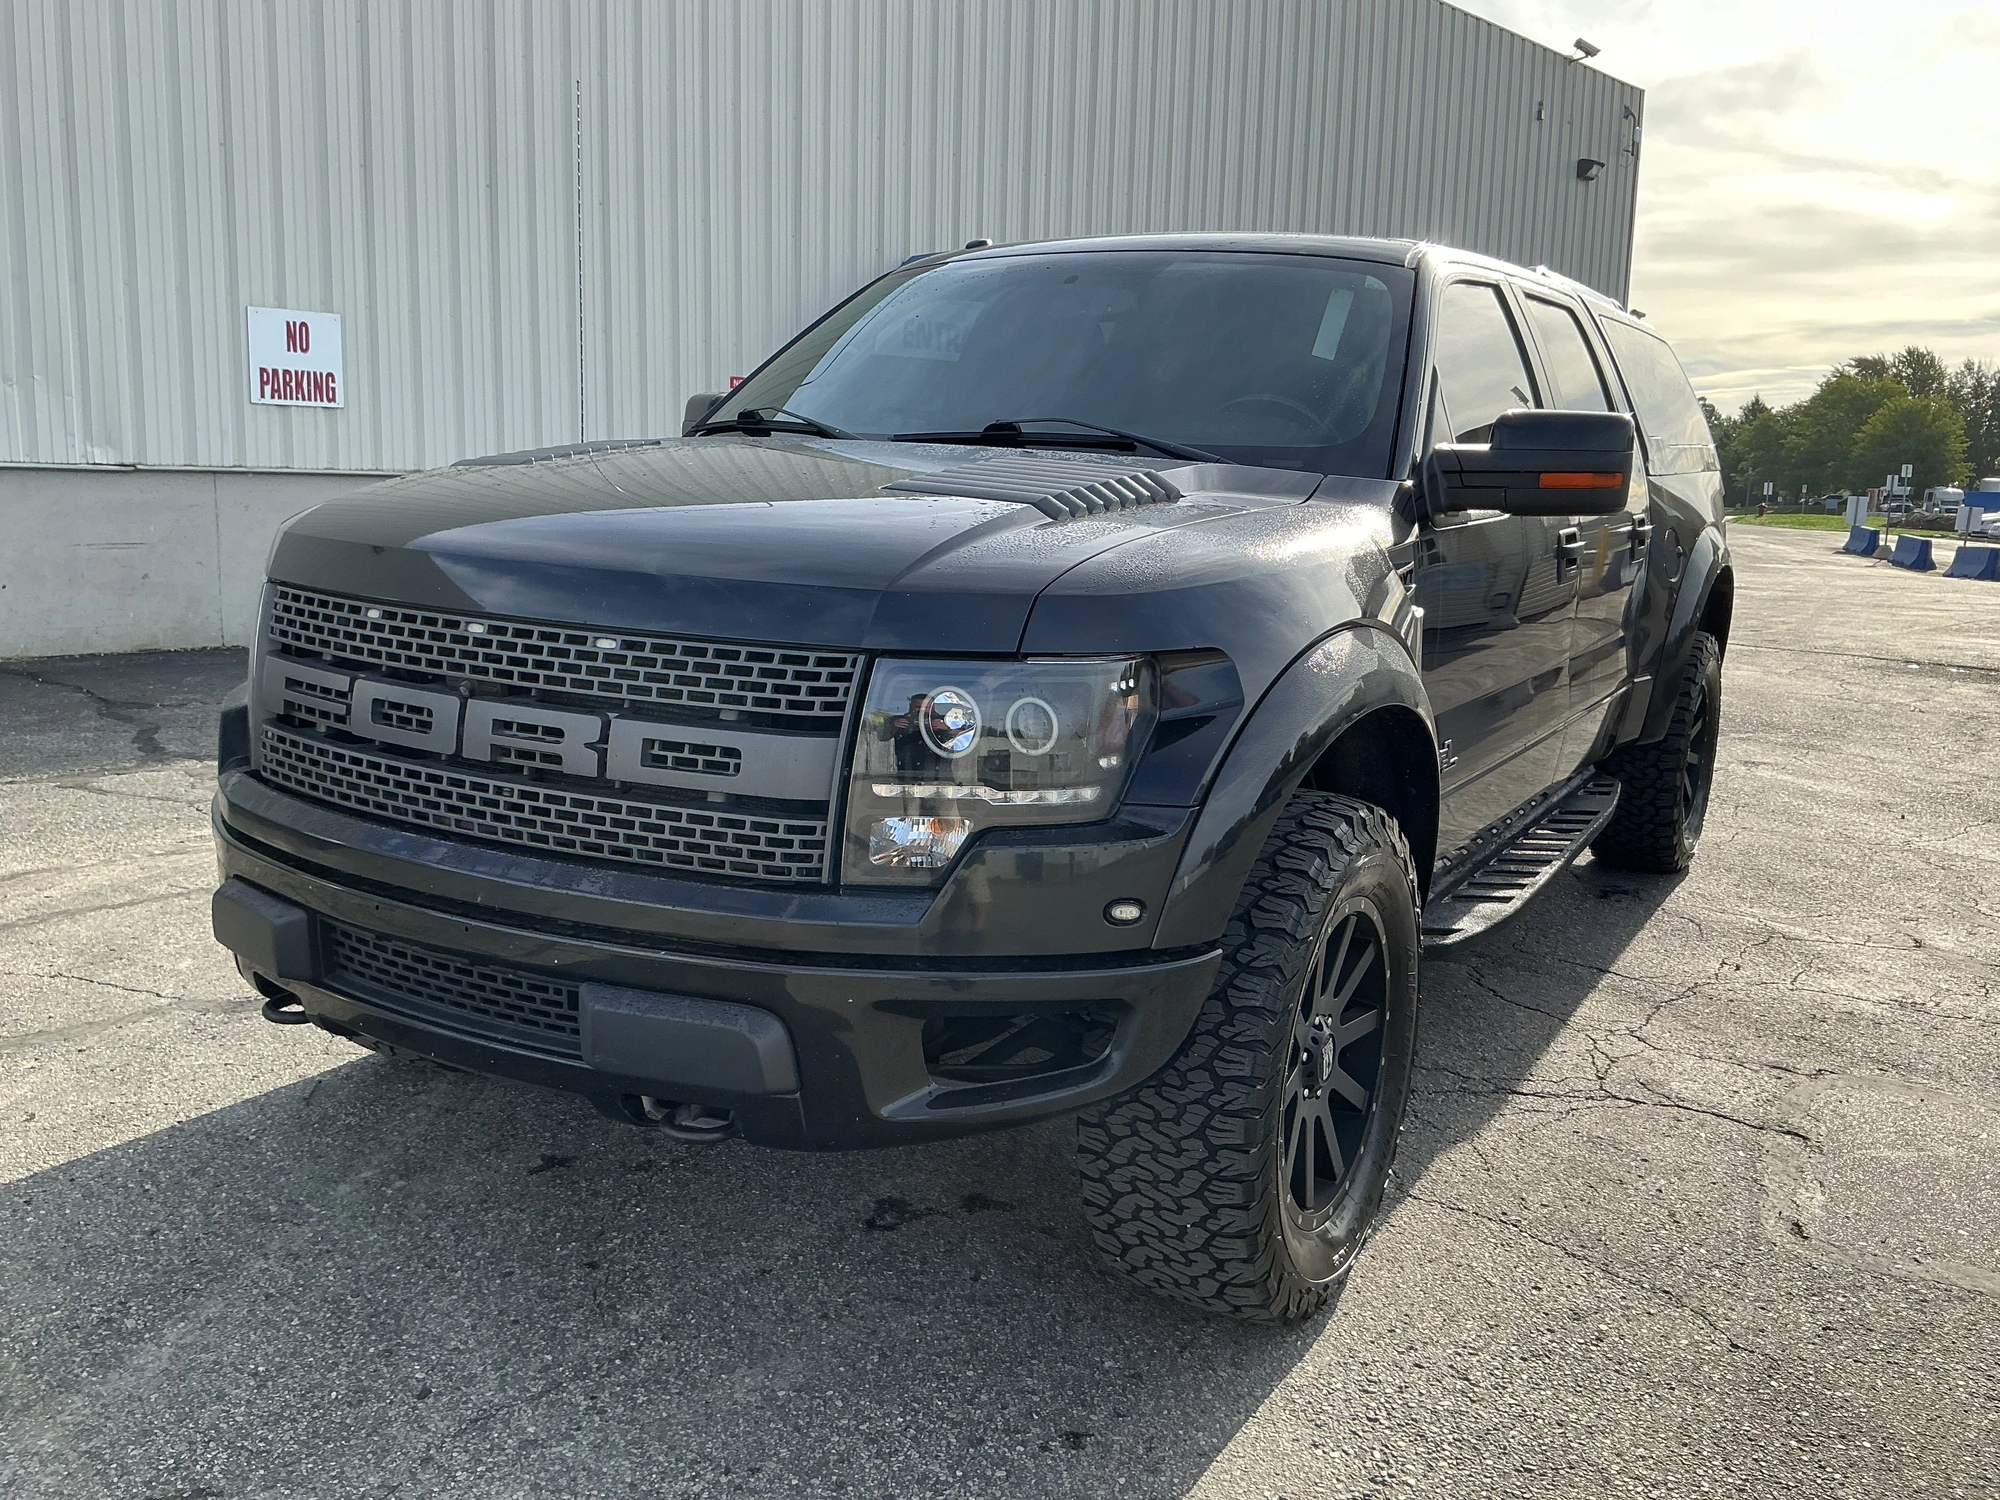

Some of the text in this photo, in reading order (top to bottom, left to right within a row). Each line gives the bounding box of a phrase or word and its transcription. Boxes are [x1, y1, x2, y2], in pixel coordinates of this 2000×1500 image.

[286, 320, 310, 354] NO
[903, 318, 965, 354] ENTR
[259, 366, 337, 404] PARKING
[263, 655, 840, 801] FORD
